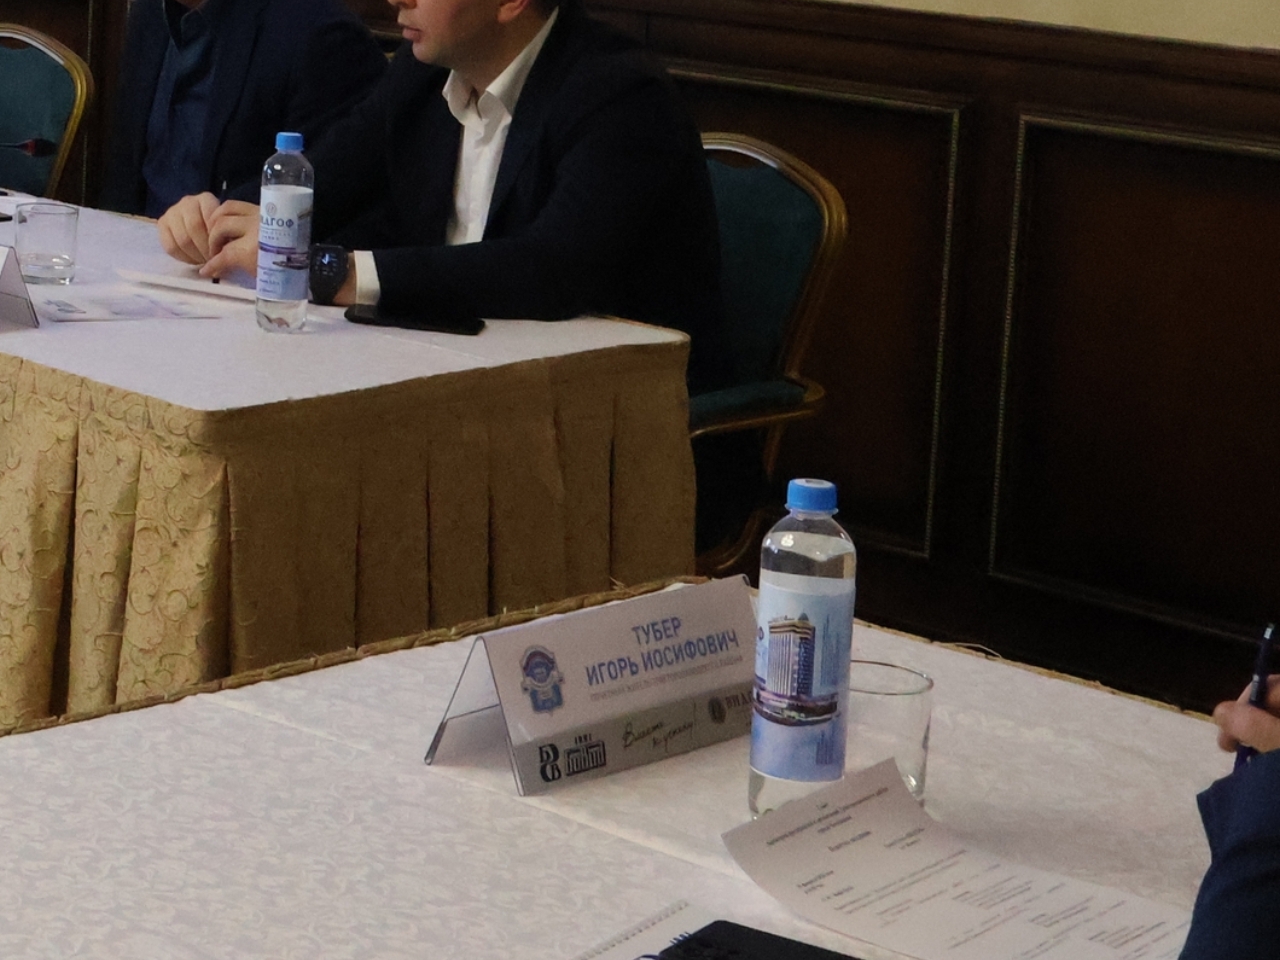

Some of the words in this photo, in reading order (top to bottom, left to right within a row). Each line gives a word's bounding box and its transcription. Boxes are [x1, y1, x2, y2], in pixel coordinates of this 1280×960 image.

[632, 617, 682, 646] ТУБЕР
[586, 657, 639, 686] ИГОРЬ
[641, 629, 739, 672] ИОСИФОВИЧ
